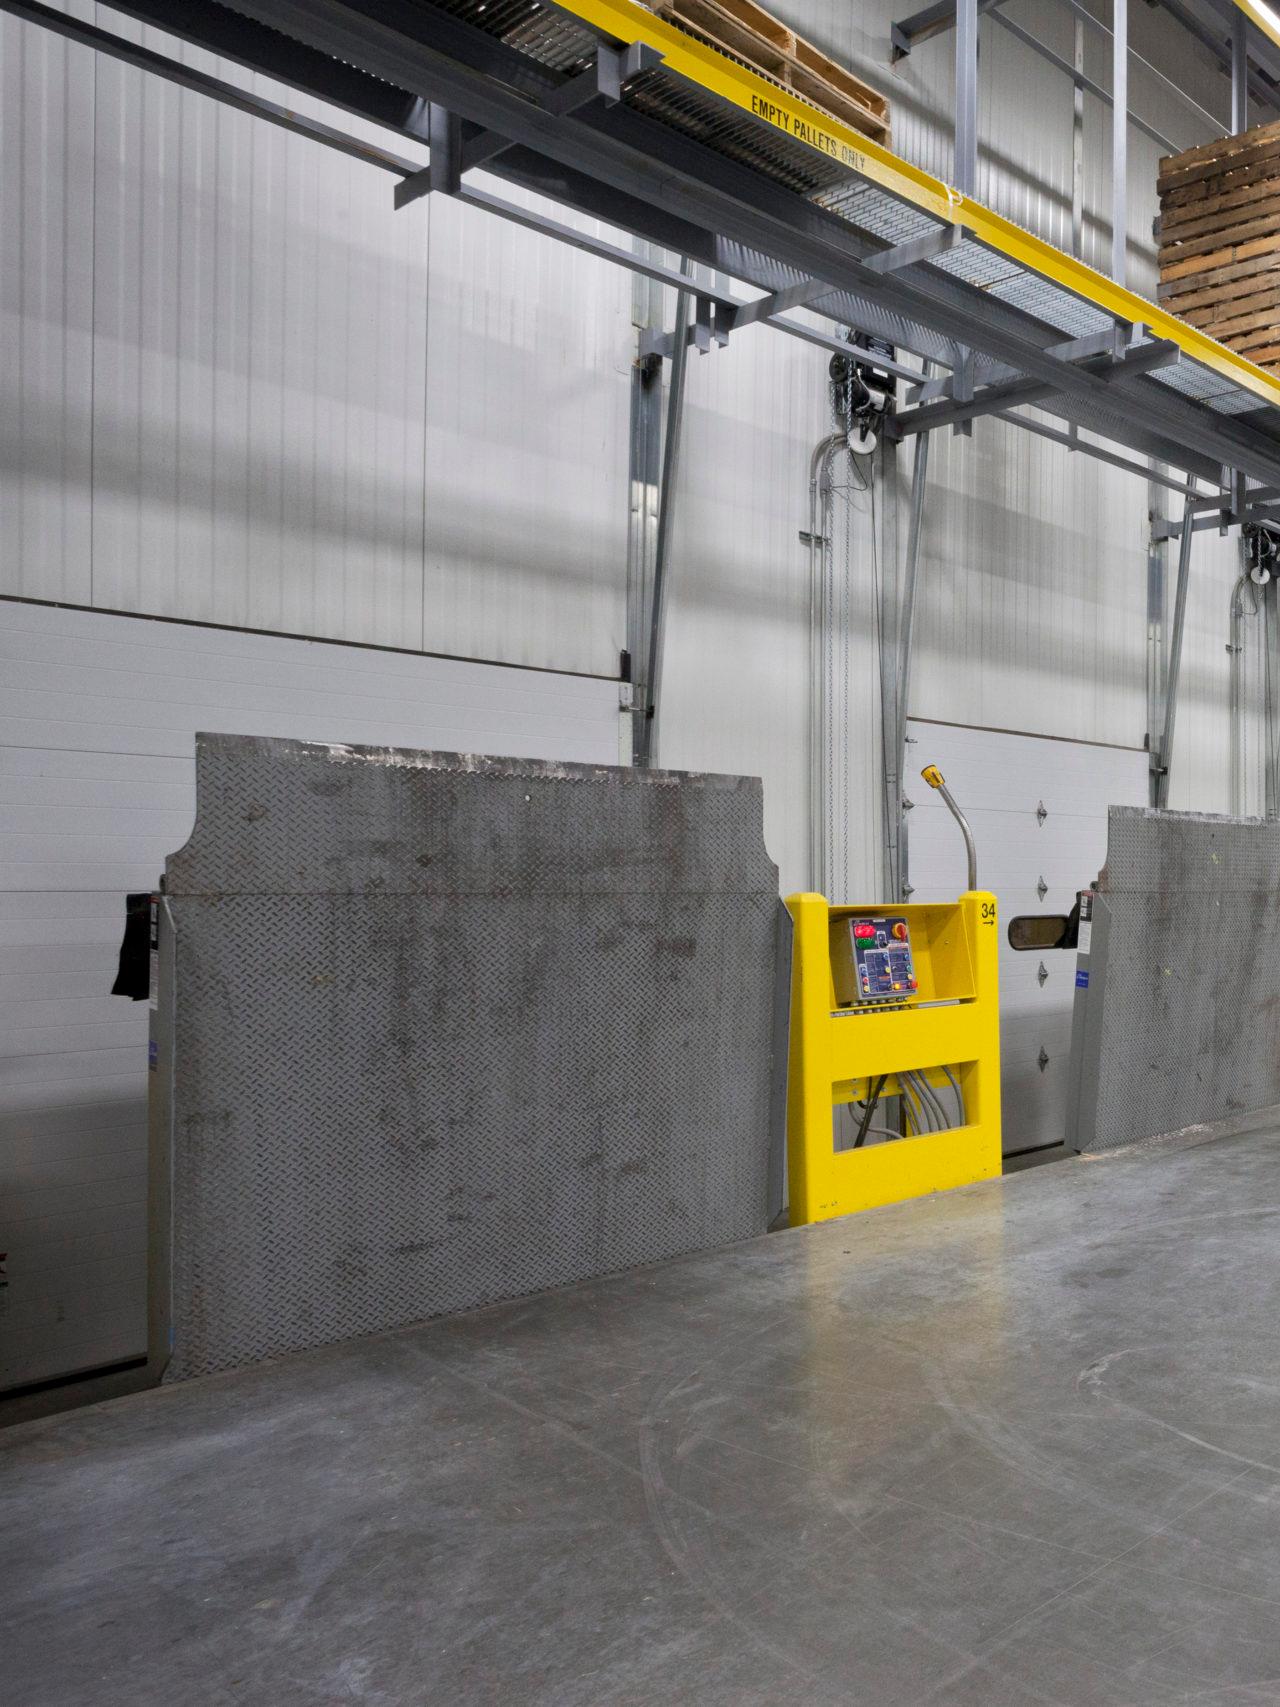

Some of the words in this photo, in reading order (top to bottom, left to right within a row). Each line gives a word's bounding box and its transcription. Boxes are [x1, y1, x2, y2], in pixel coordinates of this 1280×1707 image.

[752, 95, 789, 130] EMPTY
[794, 119, 837, 157] PALLETS
[841, 145, 865, 170] ONLY
[982, 903, 996, 918] 34
